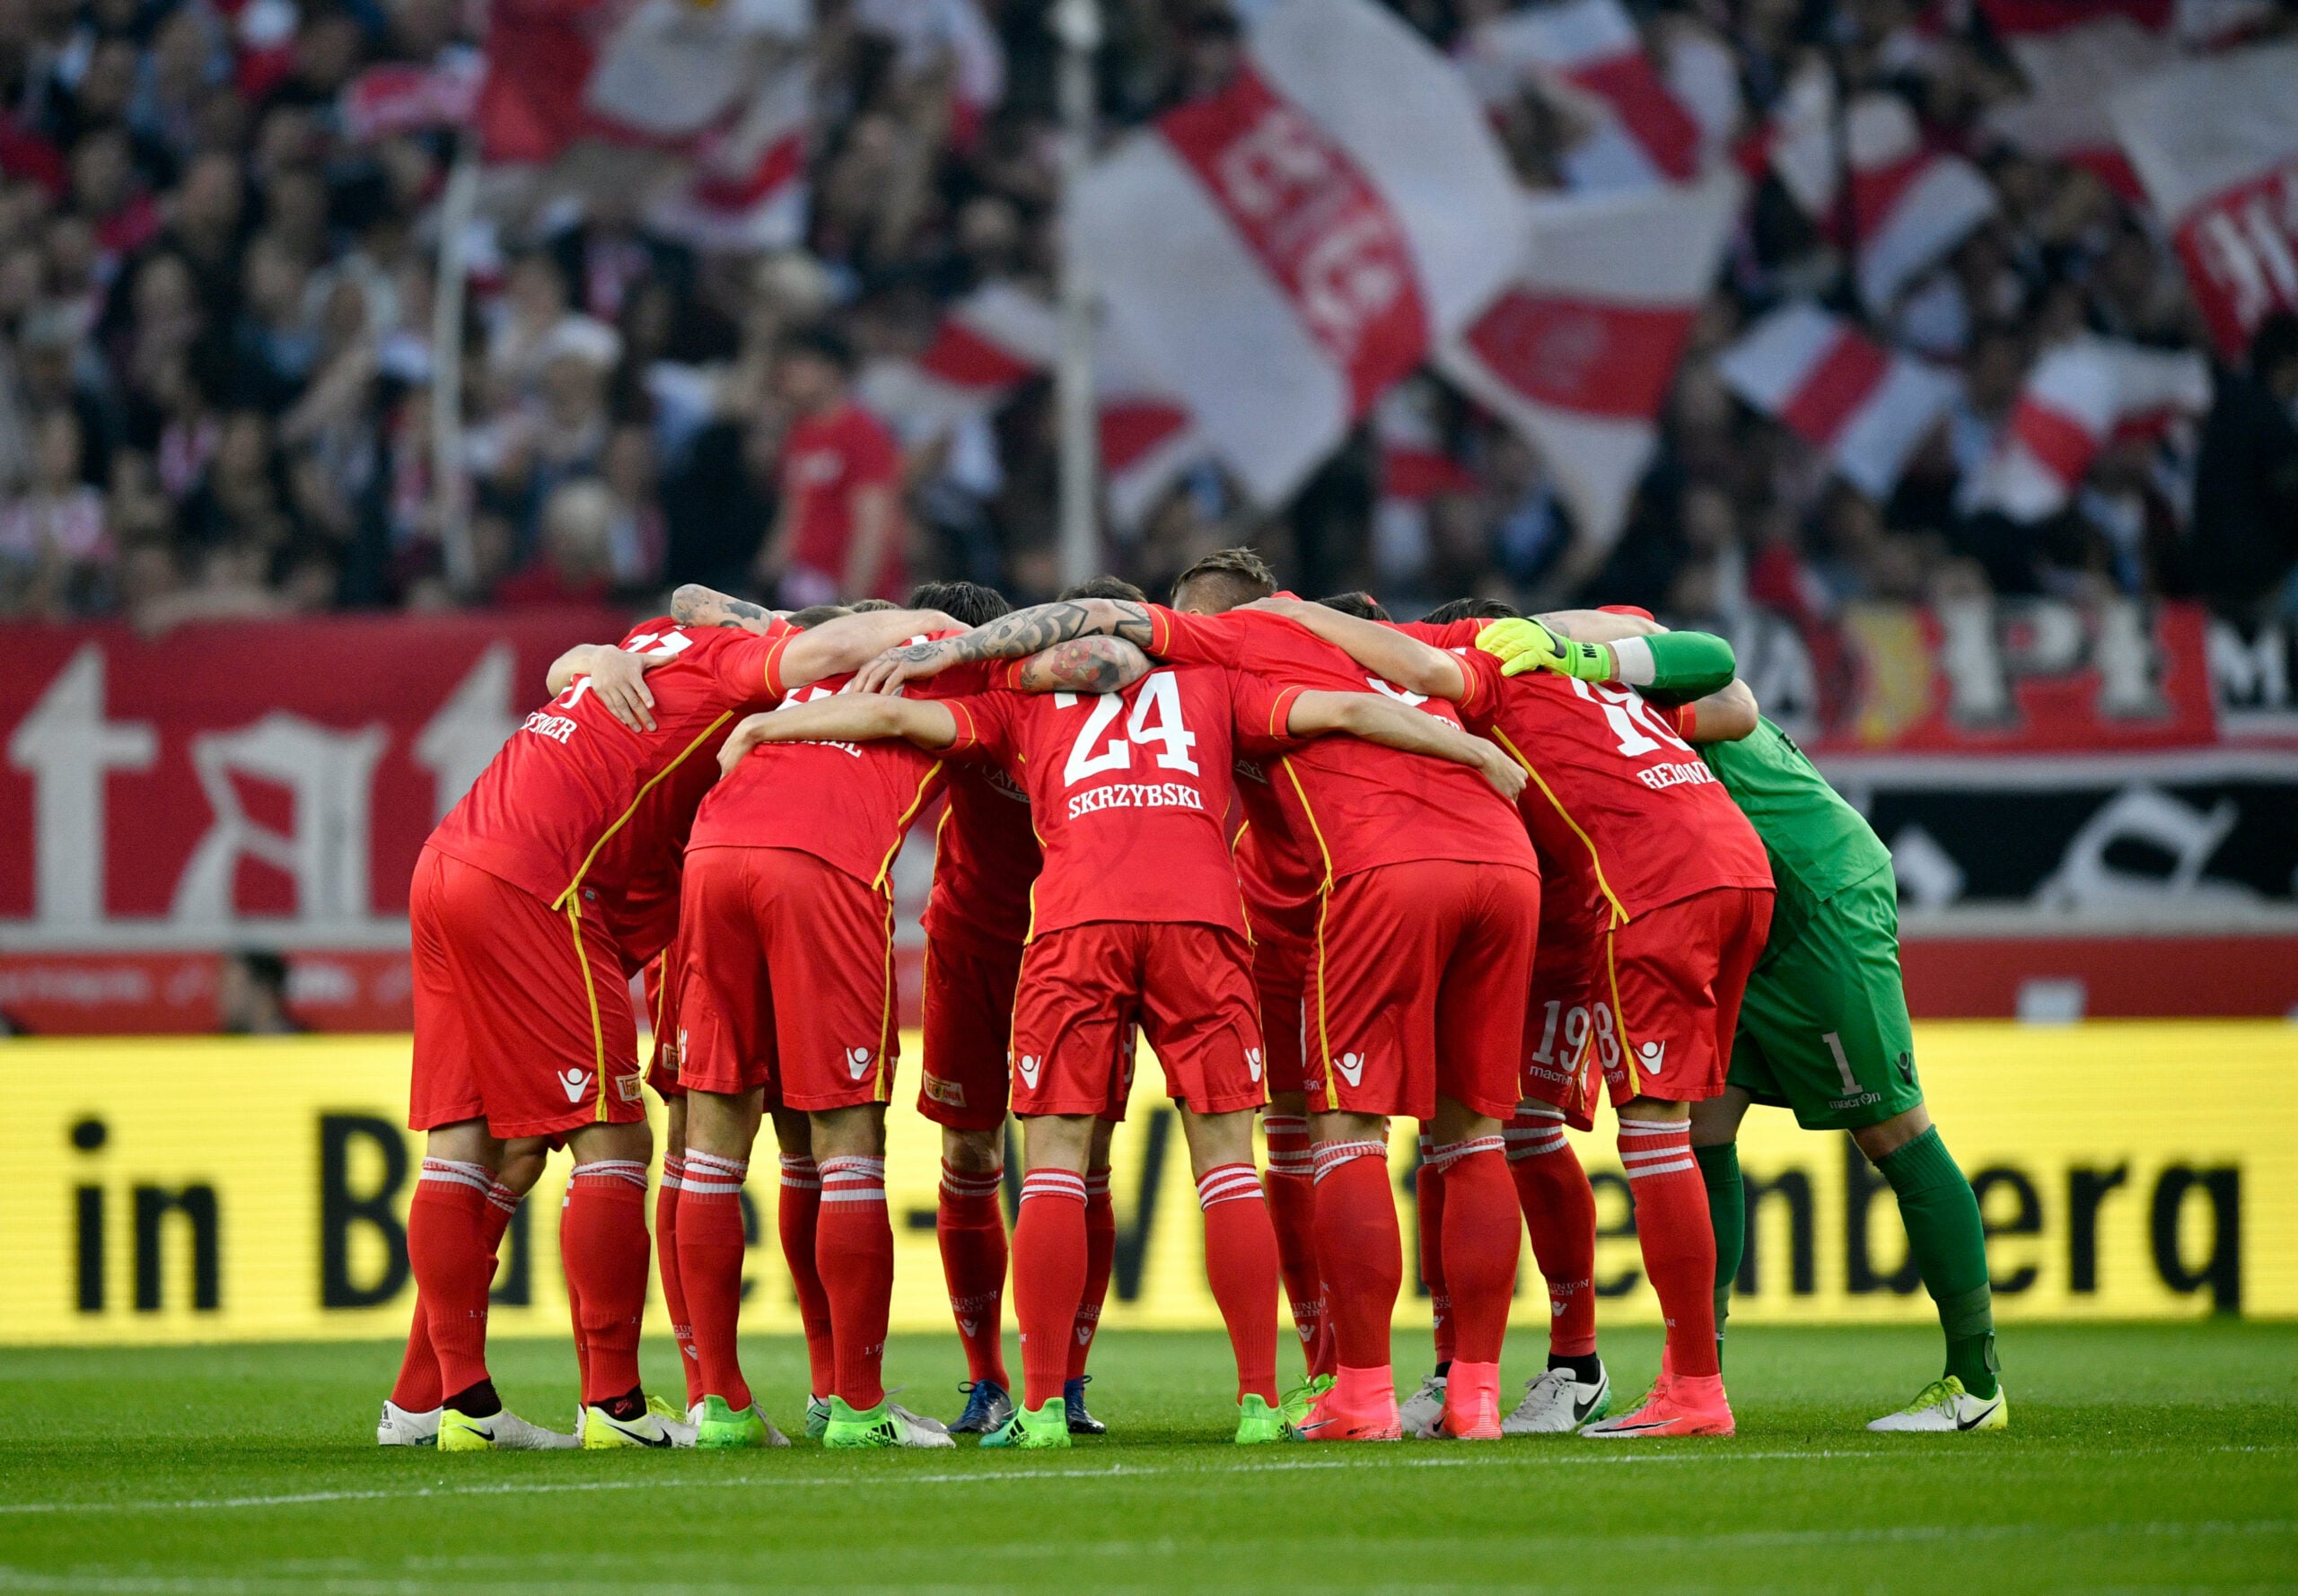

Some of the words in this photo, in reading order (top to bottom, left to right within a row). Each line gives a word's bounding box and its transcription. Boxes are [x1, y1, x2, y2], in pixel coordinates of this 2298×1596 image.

[1054, 671, 1199, 787] 24
[1068, 782, 1204, 820] SKRZYBSKI
[1531, 1000, 1590, 1072] 19
[1822, 1031, 1864, 1096] 1
[70, 1118, 219, 1311] in
